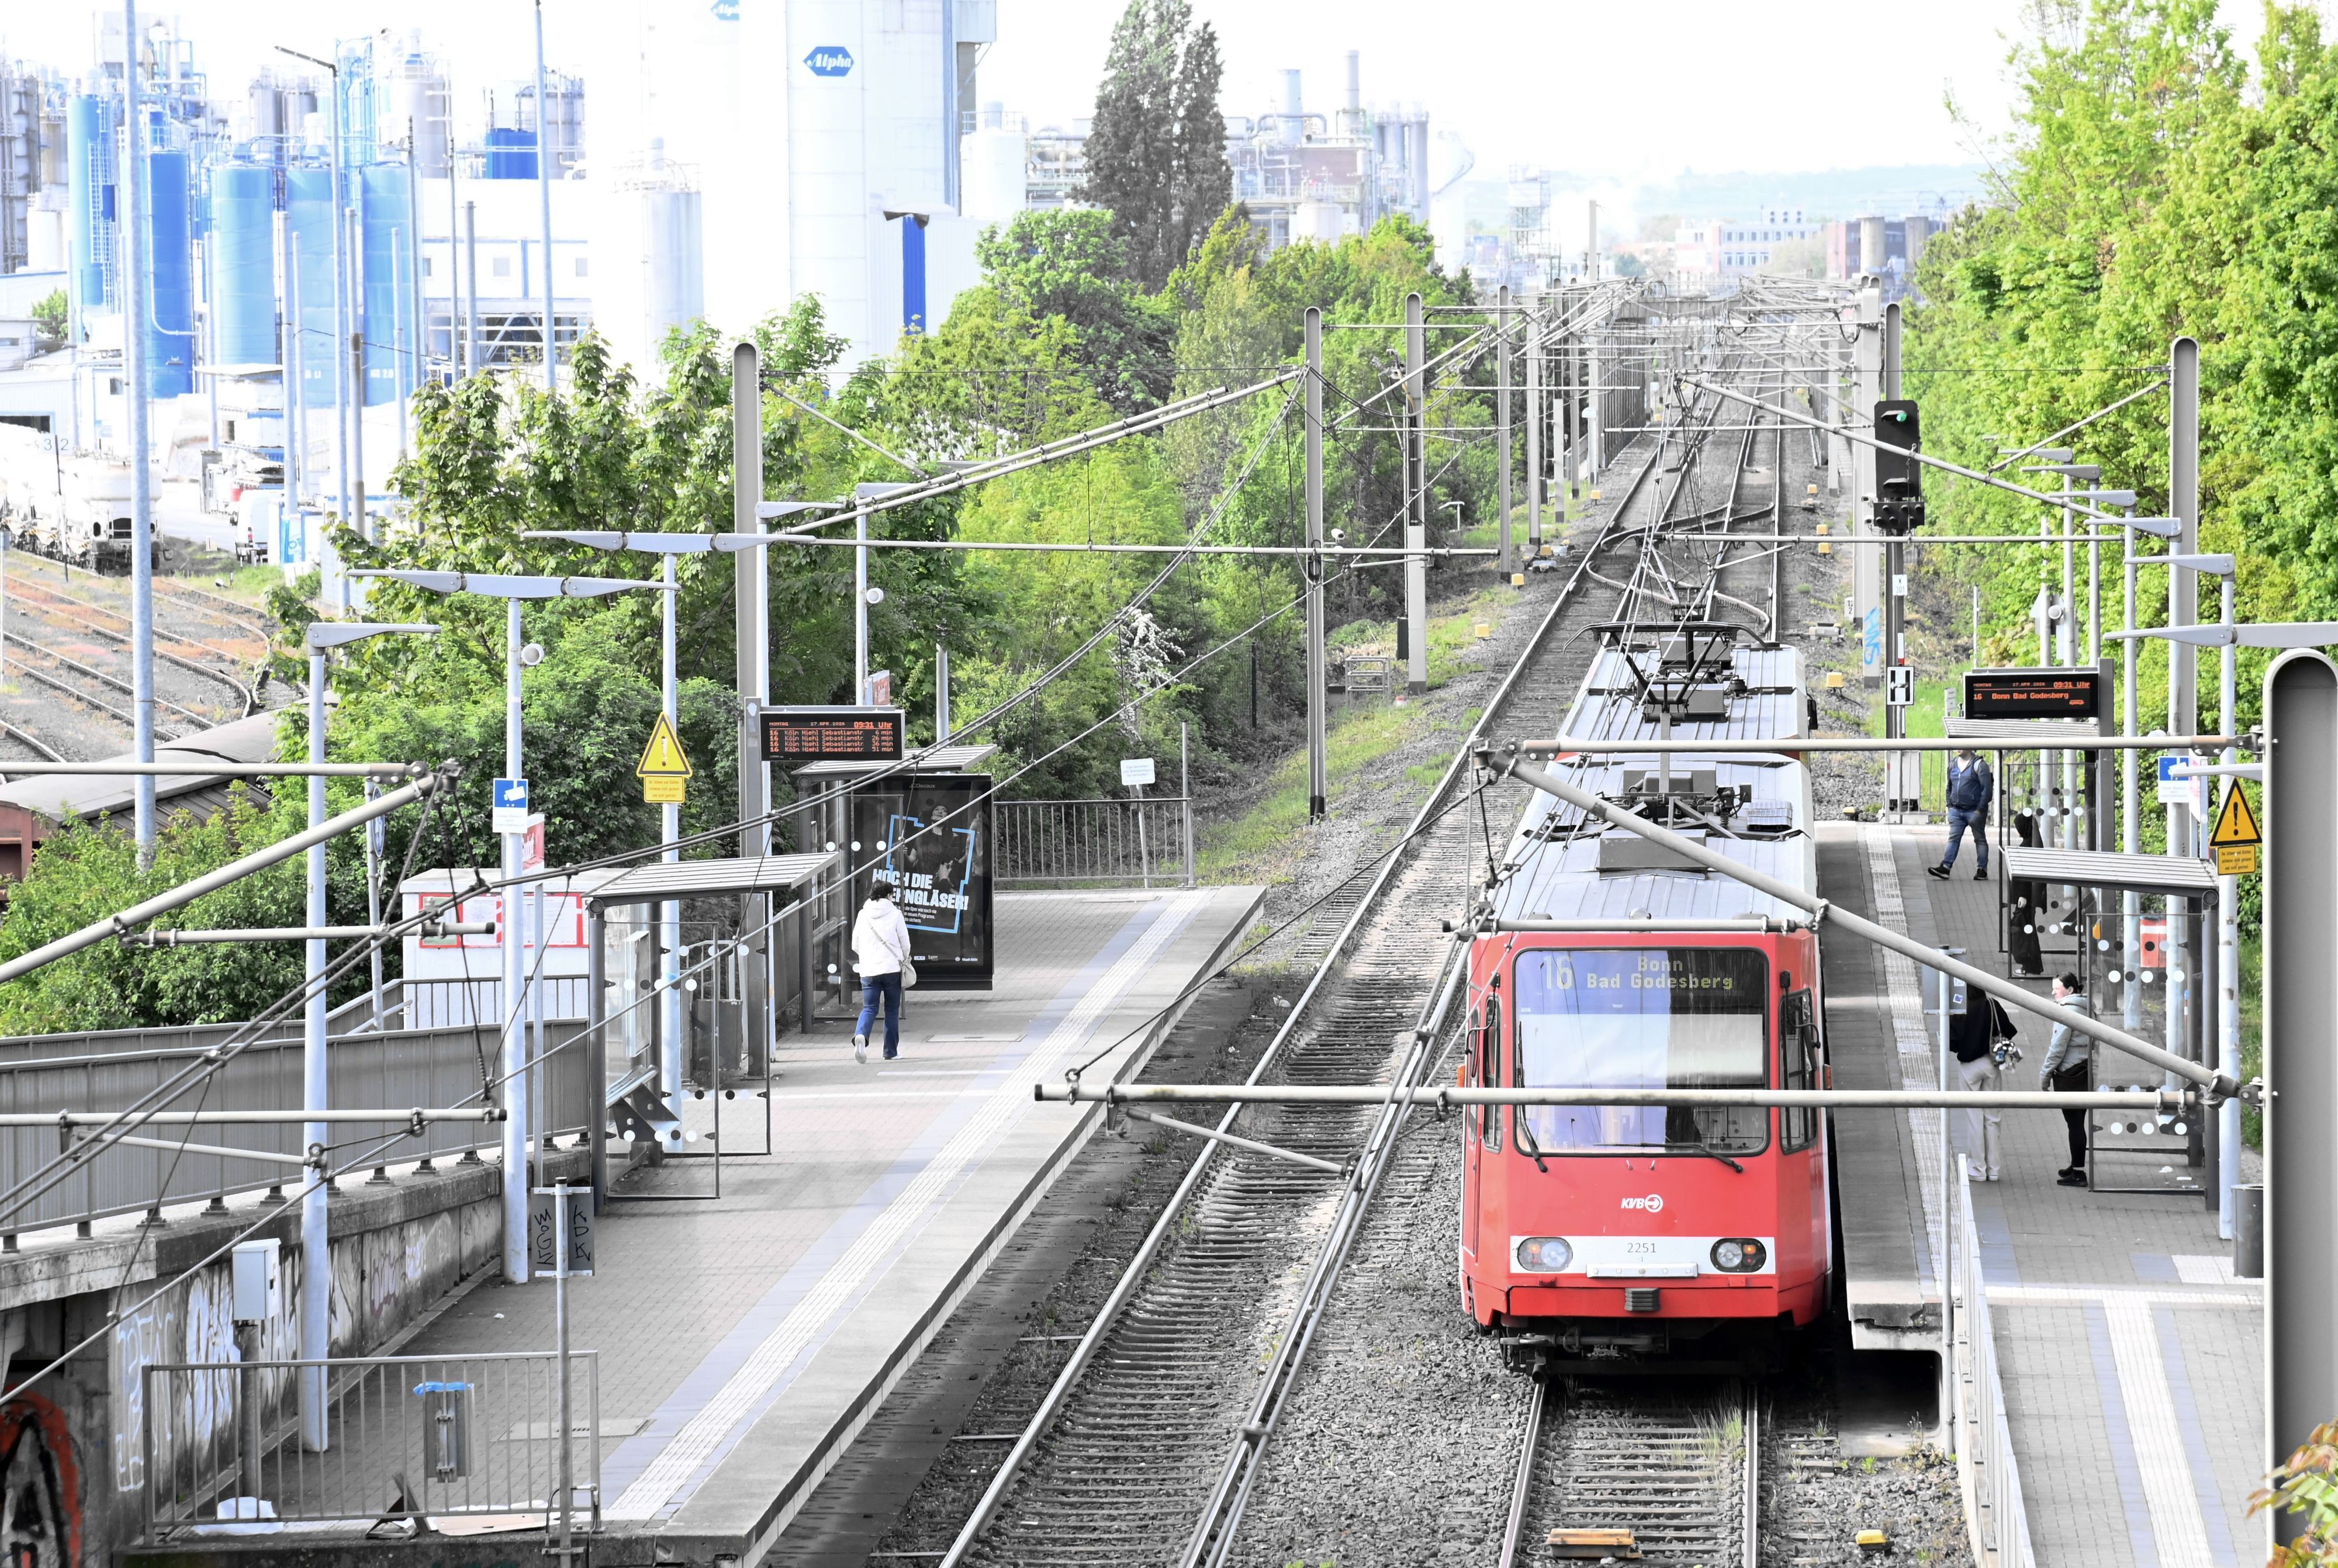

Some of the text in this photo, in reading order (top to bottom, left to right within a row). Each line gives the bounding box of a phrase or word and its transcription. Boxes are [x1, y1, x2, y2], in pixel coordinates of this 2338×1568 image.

[806, 54, 852, 71] Alpha
[44, 438, 52, 451] 3
[60, 438, 69, 451] 2
[2030, 691, 2069, 700] Godesberg
[911, 873, 933, 889] DIE
[1543, 956, 1683, 989] 16 Bonn
[1587, 973, 1733, 989] Bad Godesberg
[1620, 1197, 1645, 1209] KVB
[1627, 1242, 1657, 1253] 2251
